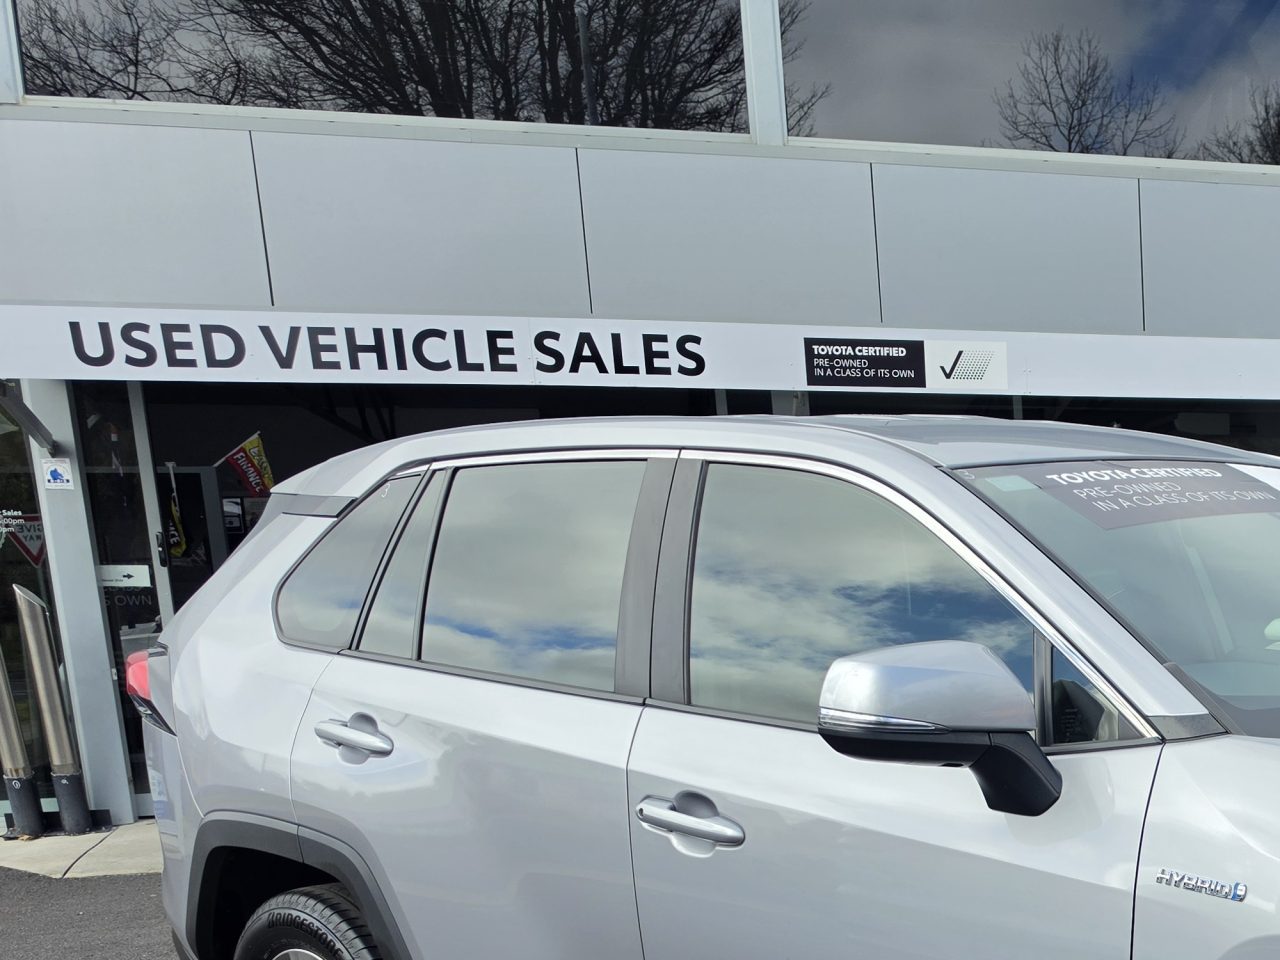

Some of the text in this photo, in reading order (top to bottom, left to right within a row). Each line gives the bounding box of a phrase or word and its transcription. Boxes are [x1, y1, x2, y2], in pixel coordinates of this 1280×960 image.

[69, 321, 707, 377] USED VEHICLE SALES
[812, 345, 907, 357] TOYOTA CERTIFIED
[813, 358, 869, 368] PRE-OWNED
[814, 368, 915, 378] IN A CLASS OF ITS OWN
[1046, 467, 1222, 485] TOYOTA CERTIFIED
[1073, 481, 1182, 499] PRE-OWNED
[1092, 490, 1277, 512] IN A CLASS OF ITS OWN
[1156, 868, 1233, 900] HYBRID
[266, 911, 343, 958] BRIDGESTONE
